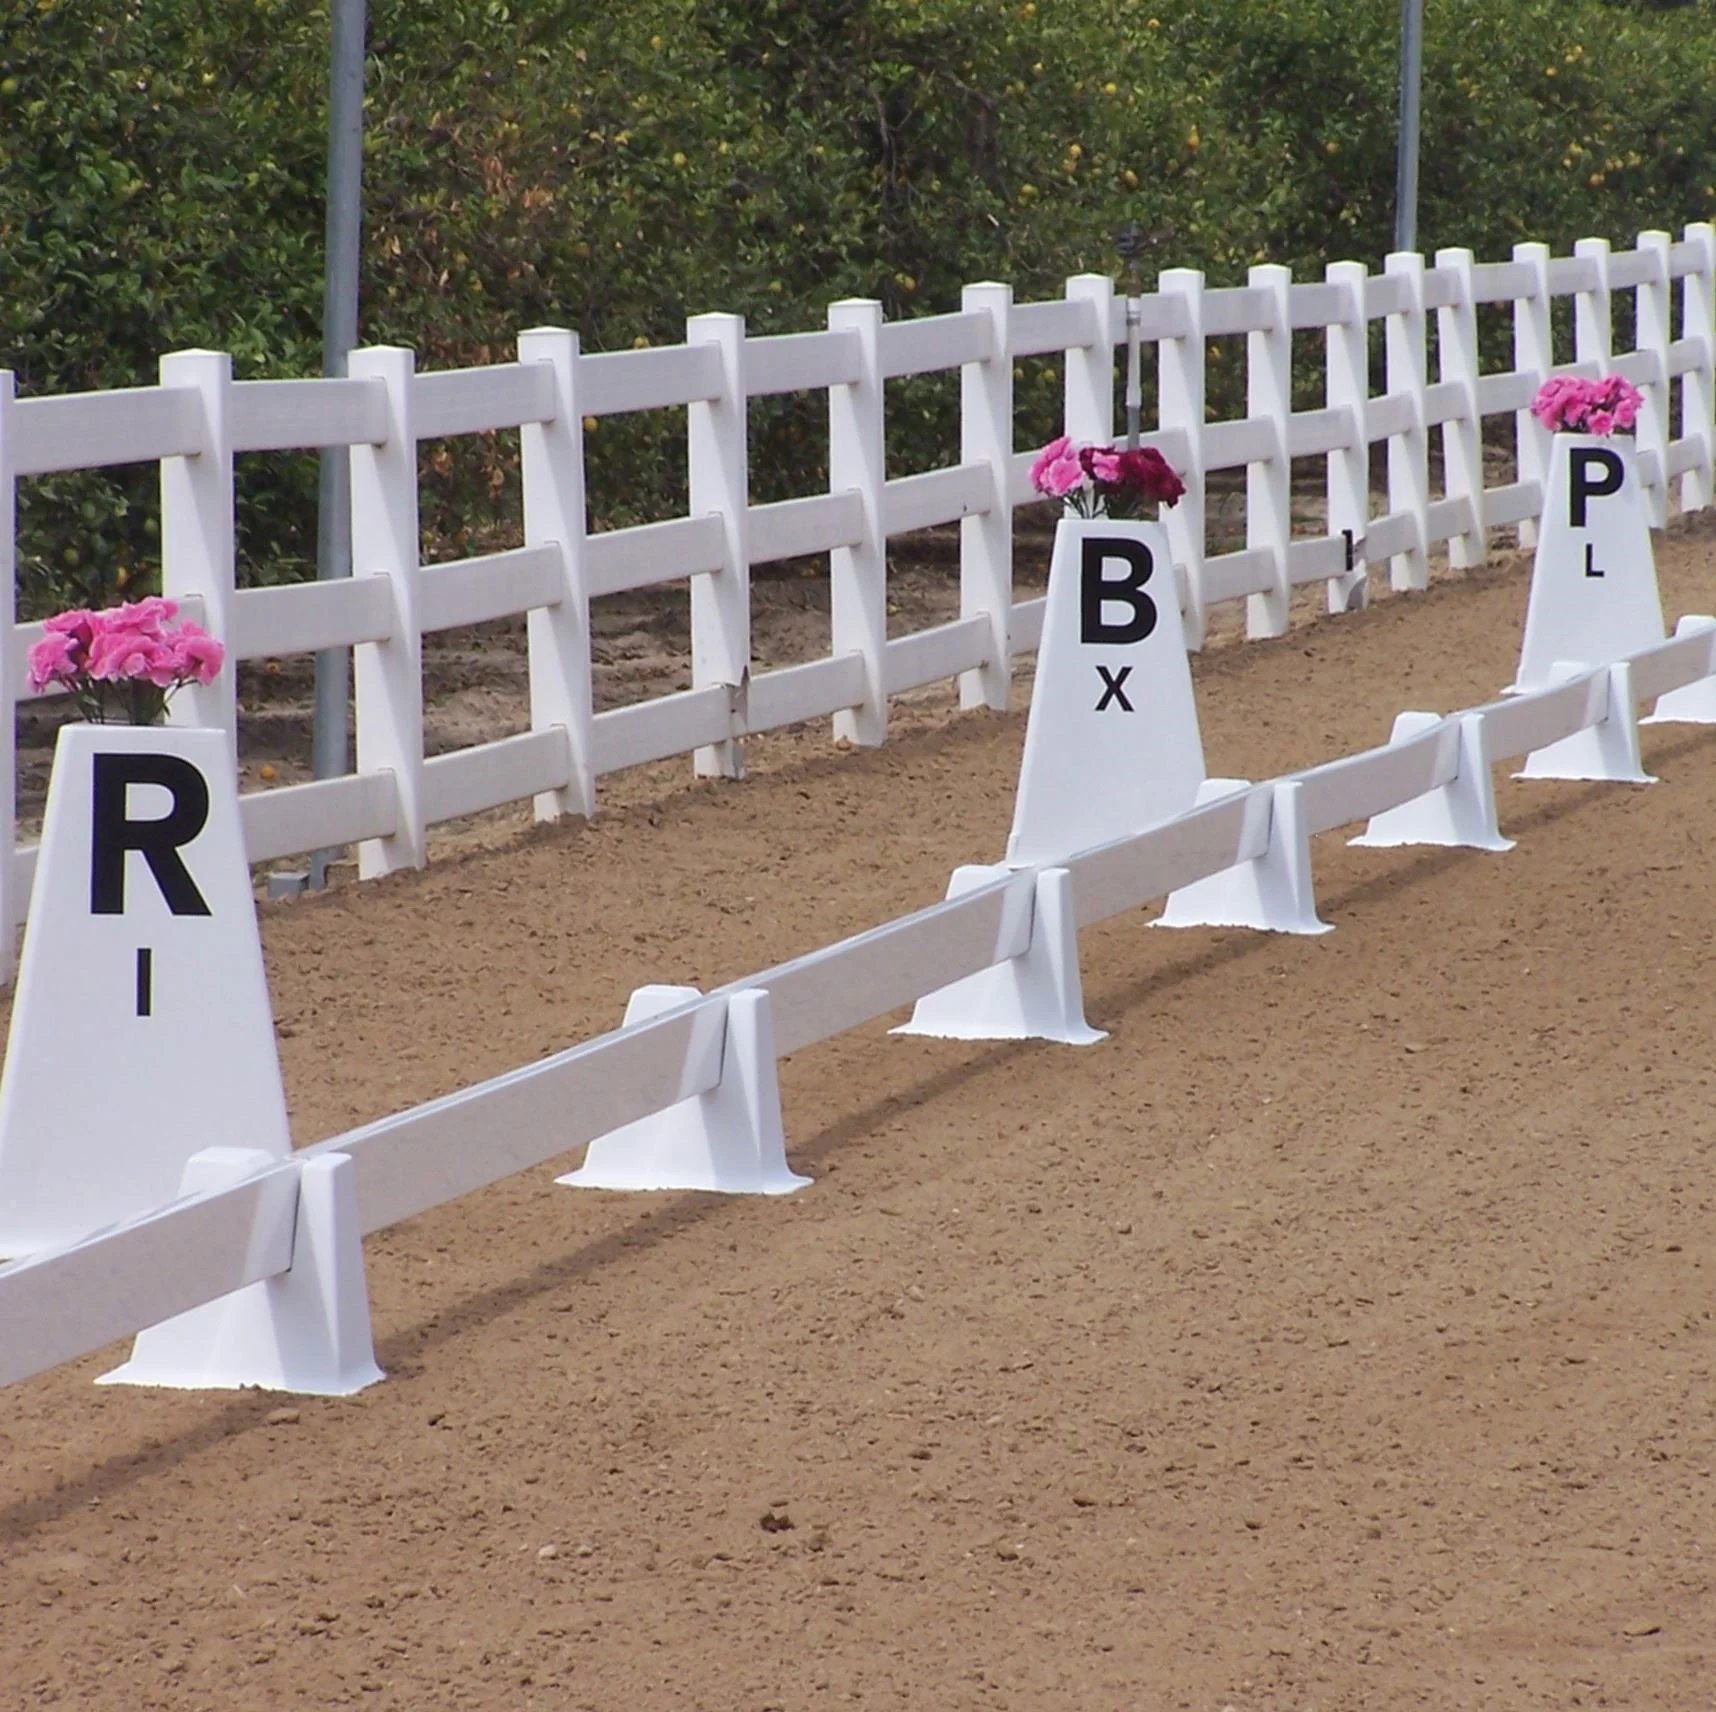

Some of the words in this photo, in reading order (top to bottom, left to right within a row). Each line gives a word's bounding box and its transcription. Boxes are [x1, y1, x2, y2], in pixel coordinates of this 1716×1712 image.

[1569, 447, 1625, 528] P
[1080, 537, 1158, 645] B
[1585, 543, 1605, 578] L
[1095, 665, 1134, 713] X
[90, 752, 213, 917] R
[136, 947, 152, 1017] I
